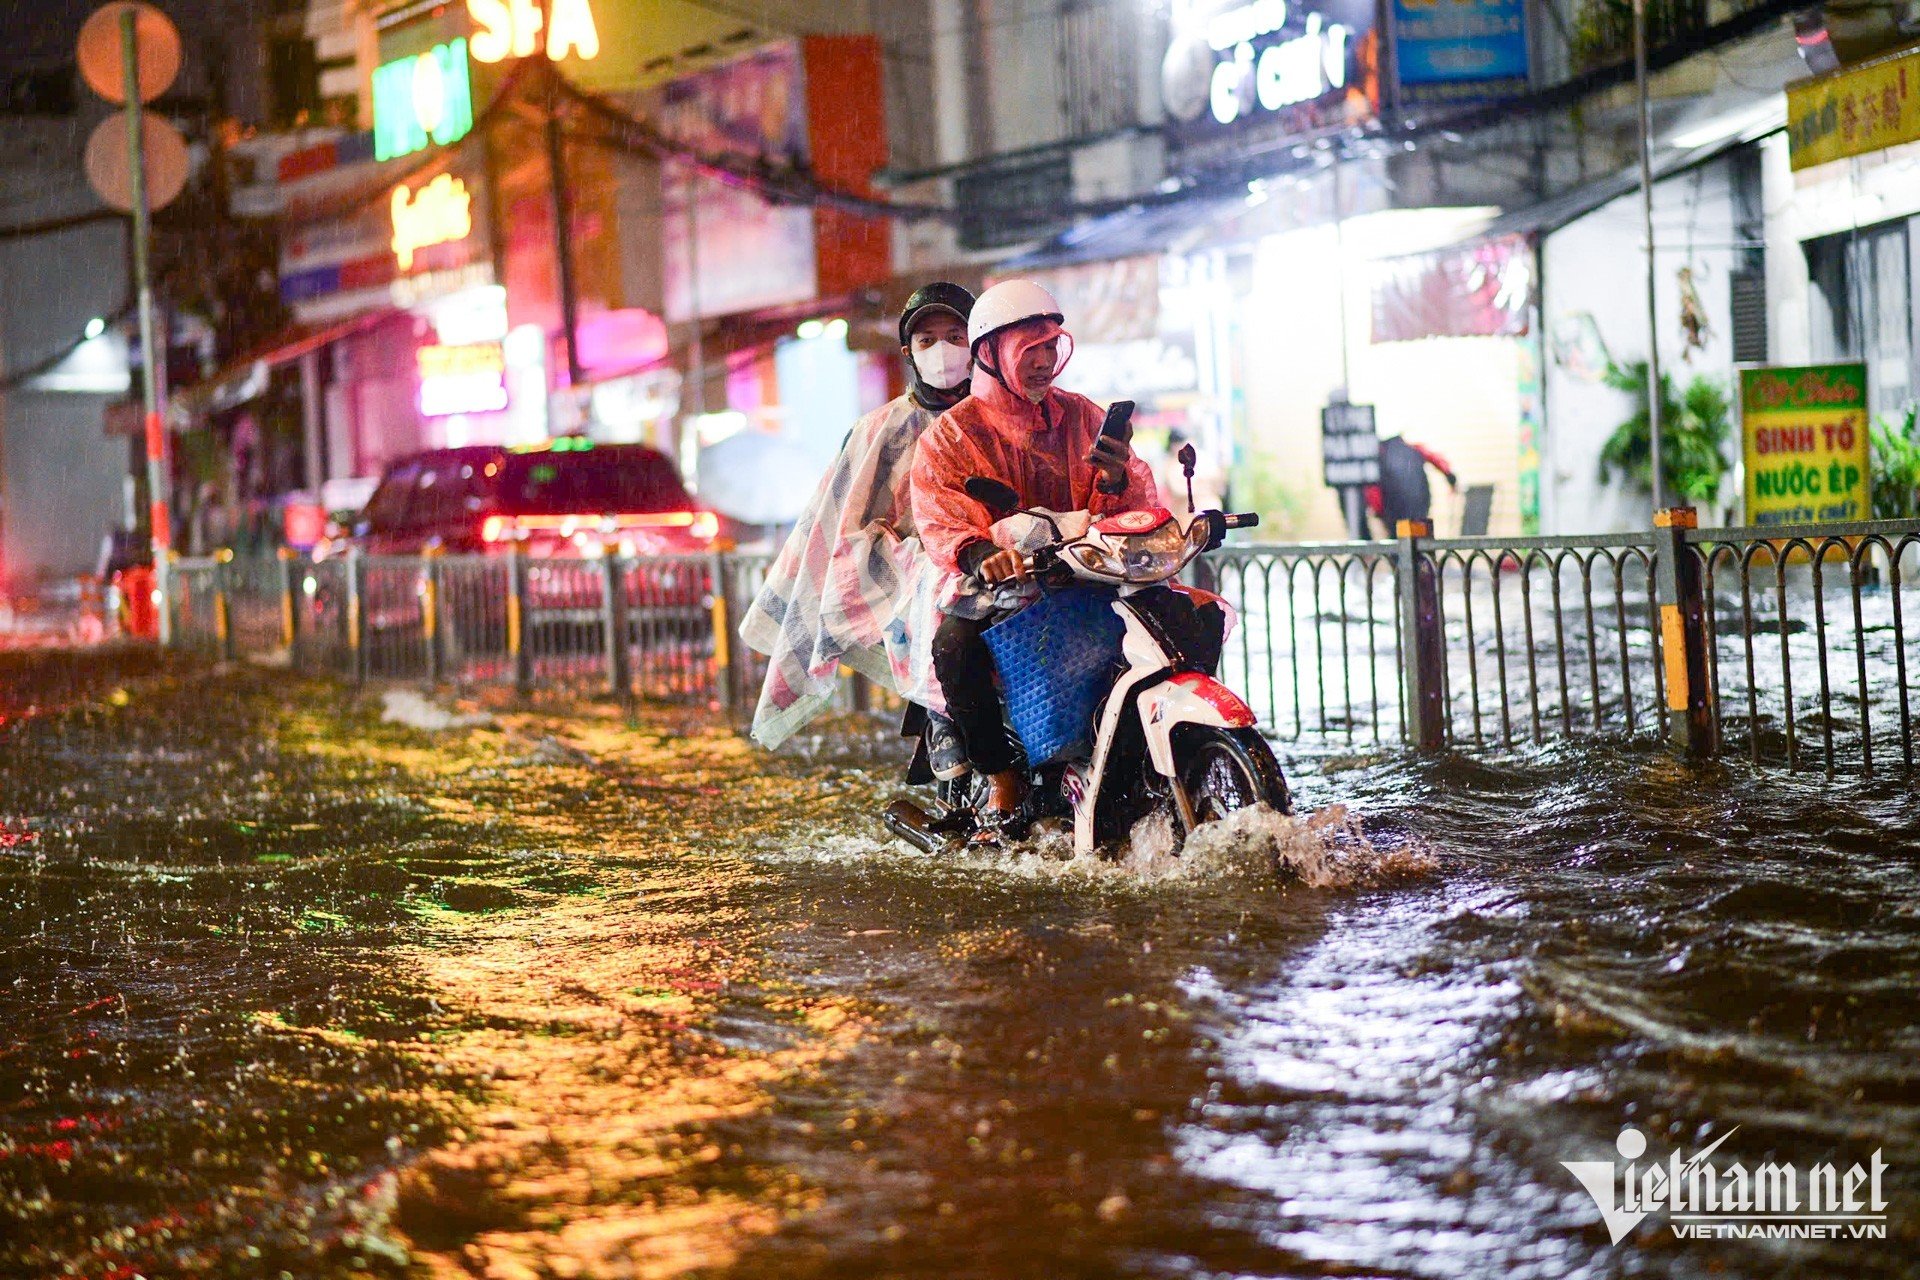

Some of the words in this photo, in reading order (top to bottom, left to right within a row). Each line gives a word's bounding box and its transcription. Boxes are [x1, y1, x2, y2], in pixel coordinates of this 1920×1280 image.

[1756, 425, 1815, 454] SINH
[1822, 416, 1856, 451] TỐ
[1756, 461, 1821, 497] NƯỚC
